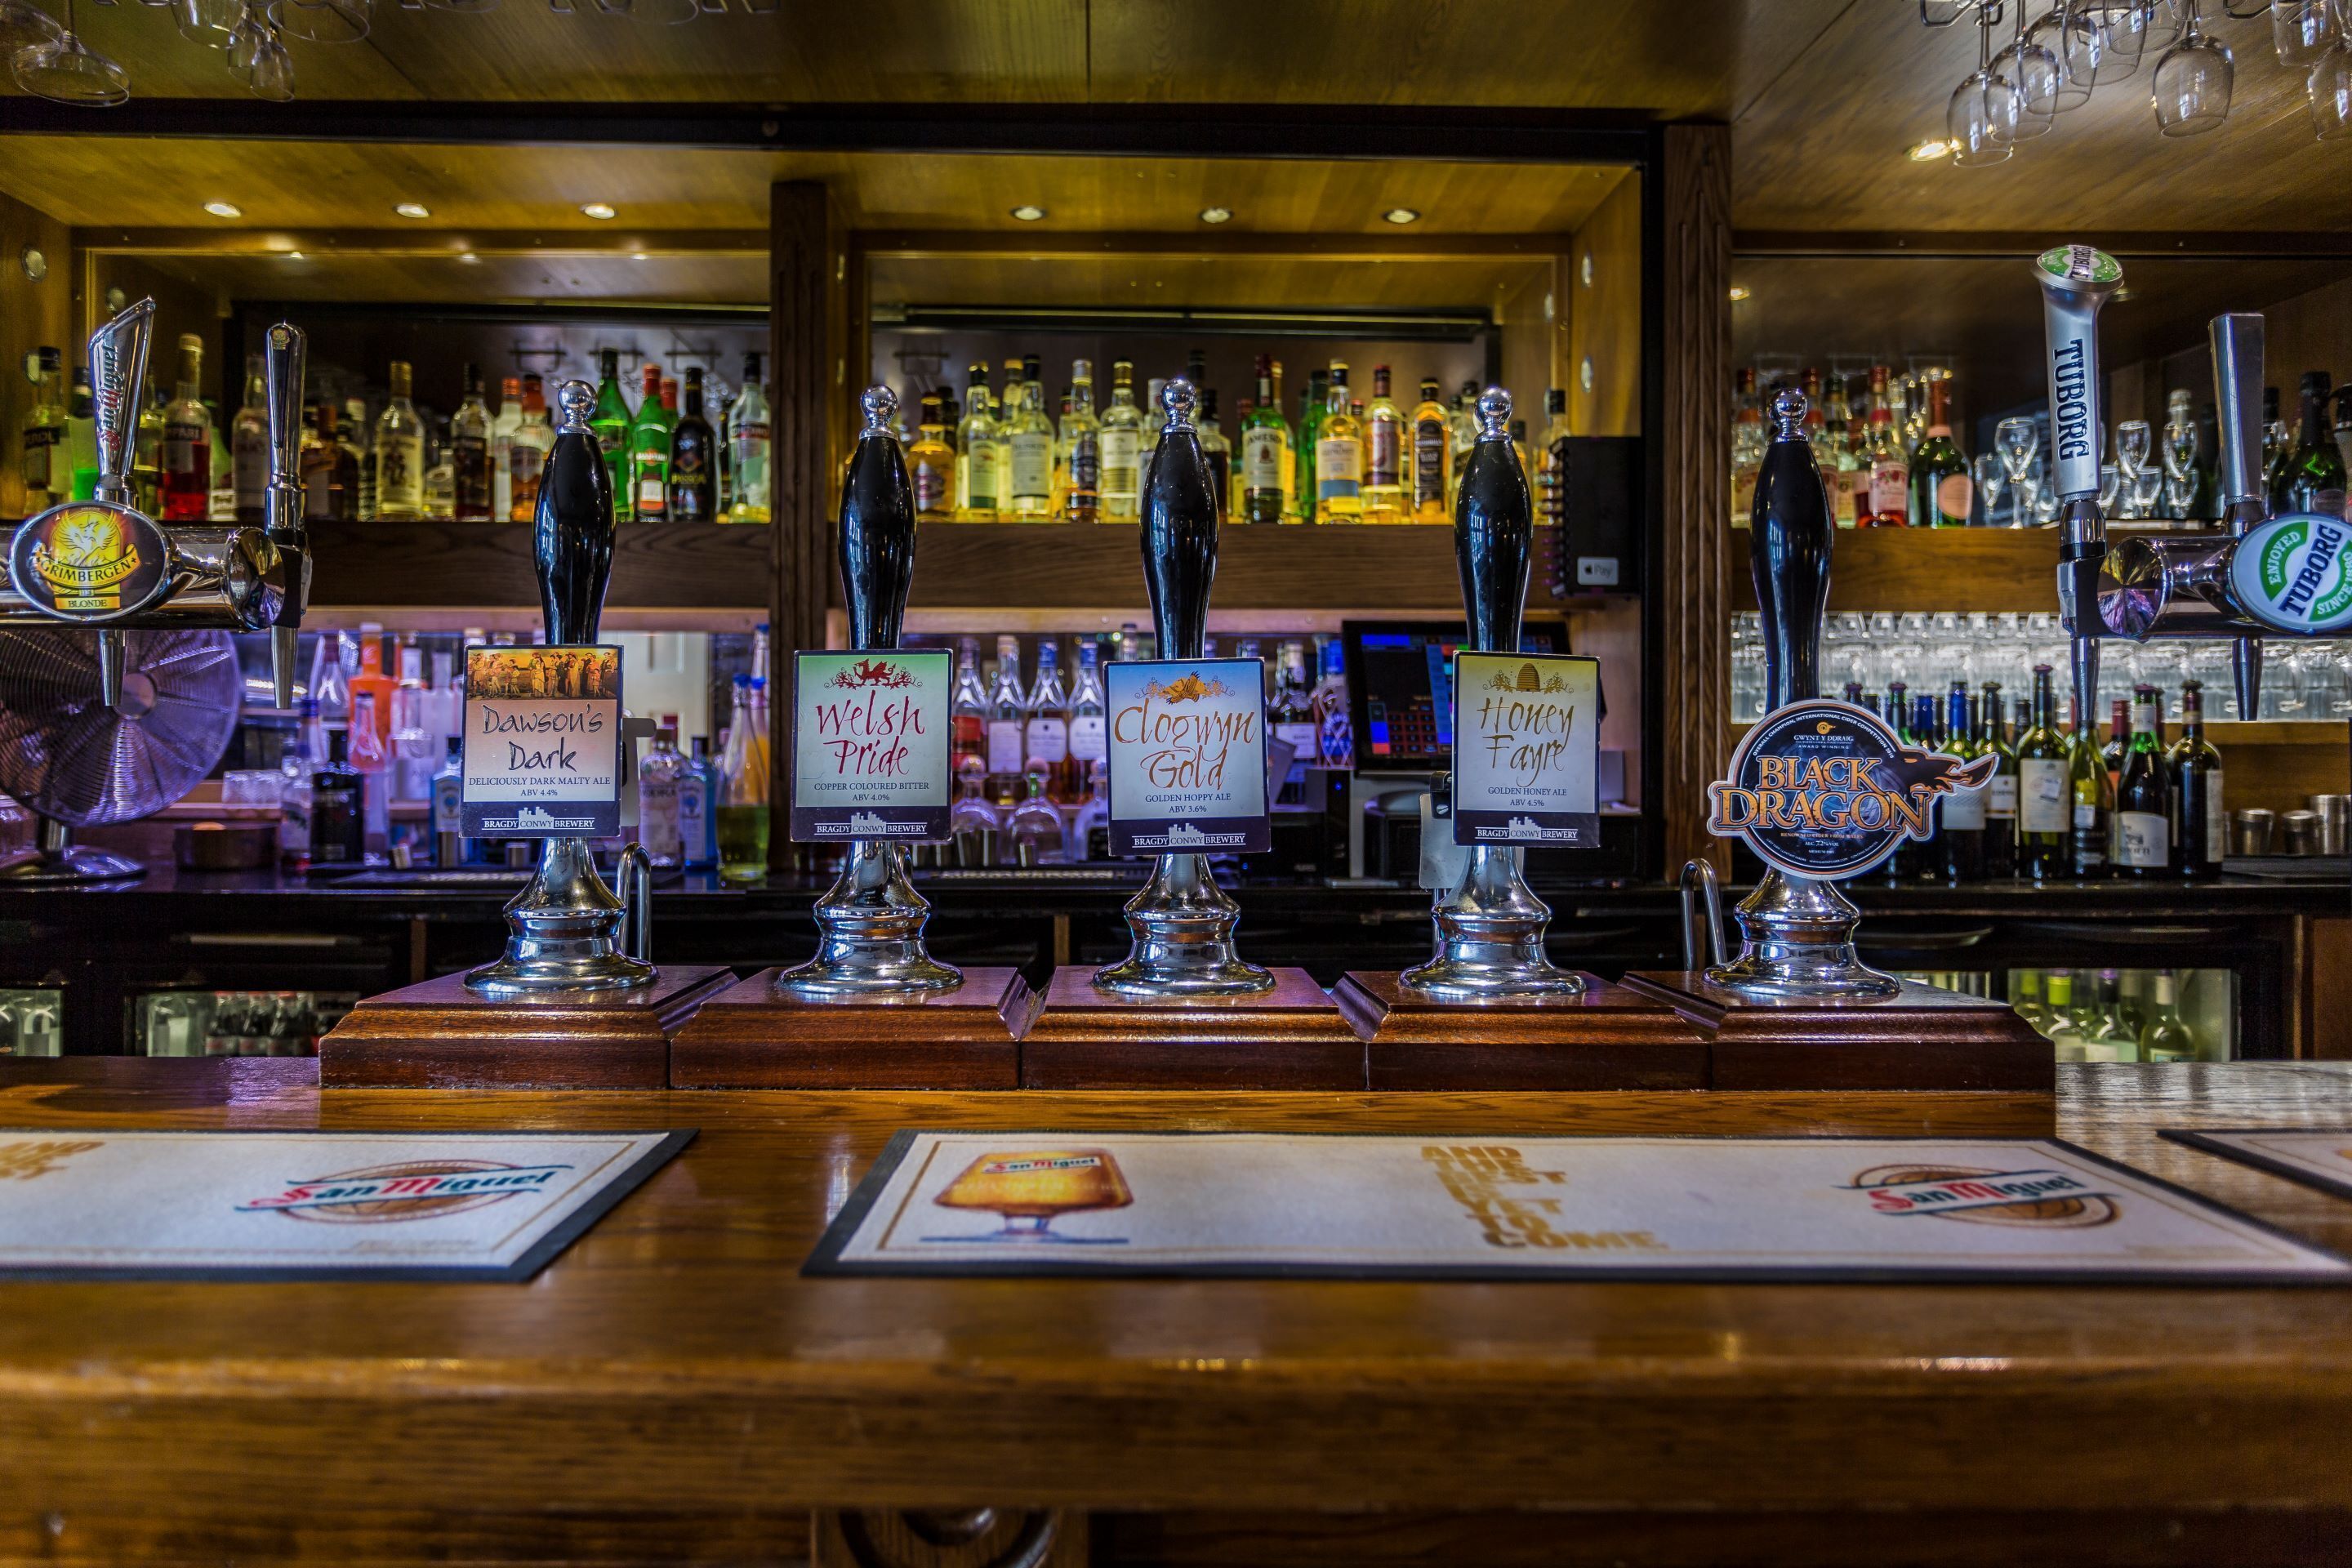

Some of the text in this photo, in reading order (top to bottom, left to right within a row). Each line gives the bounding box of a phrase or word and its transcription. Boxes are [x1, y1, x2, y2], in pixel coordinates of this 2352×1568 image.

[2053, 338, 2090, 461] TUBORG
[41, 559, 131, 582] GRIMBERGEN
[2266, 532, 2301, 585] ENJOYED
[2277, 523, 2343, 617] TUBORG
[2317, 583, 2352, 615] SINCE
[483, 703, 604, 734] Dawson's
[816, 690, 924, 736] Welsh
[1114, 698, 1257, 761] Clogwyn
[1477, 697, 1575, 749] Honey
[1753, 713, 1895, 759] OVERALL CHAMPION, INTERNATIONAL CIDER COMPETITION 2010
[508, 737, 577, 772] Dark
[823, 736, 910, 777] Pride
[1140, 745, 1227, 791] Gold
[1482, 735, 1565, 787] Fayre
[469, 777, 611, 786] DELICIOUSLY DARK MALTY ALE
[814, 782, 929, 791] COPPER COLOURED BITTER
[1488, 786, 1567, 796] GOLDEN HONEY ALE
[1756, 756, 1882, 792] BLACK
[1145, 793, 1232, 803] GOLDEN HOPPY ALE
[1169, 805, 1186, 813] ABV
[1716, 789, 1929, 837] DRAGON
[483, 819, 595, 829] BRAGDY CONWY BREWERY
[817, 825, 927, 834] BRAGDY CONWY BREWERY
[1134, 835, 1245, 846] BRAGDY CONWY BREWERY
[1477, 829, 1577, 839] BRAGDY CONWY BREWERY
[985, 1157, 1096, 1173] San Miguel
[1421, 1146, 1521, 1160] AND
[248, 1172, 556, 1206] San Miguel
[1868, 1174, 2087, 1212] San Miguel
